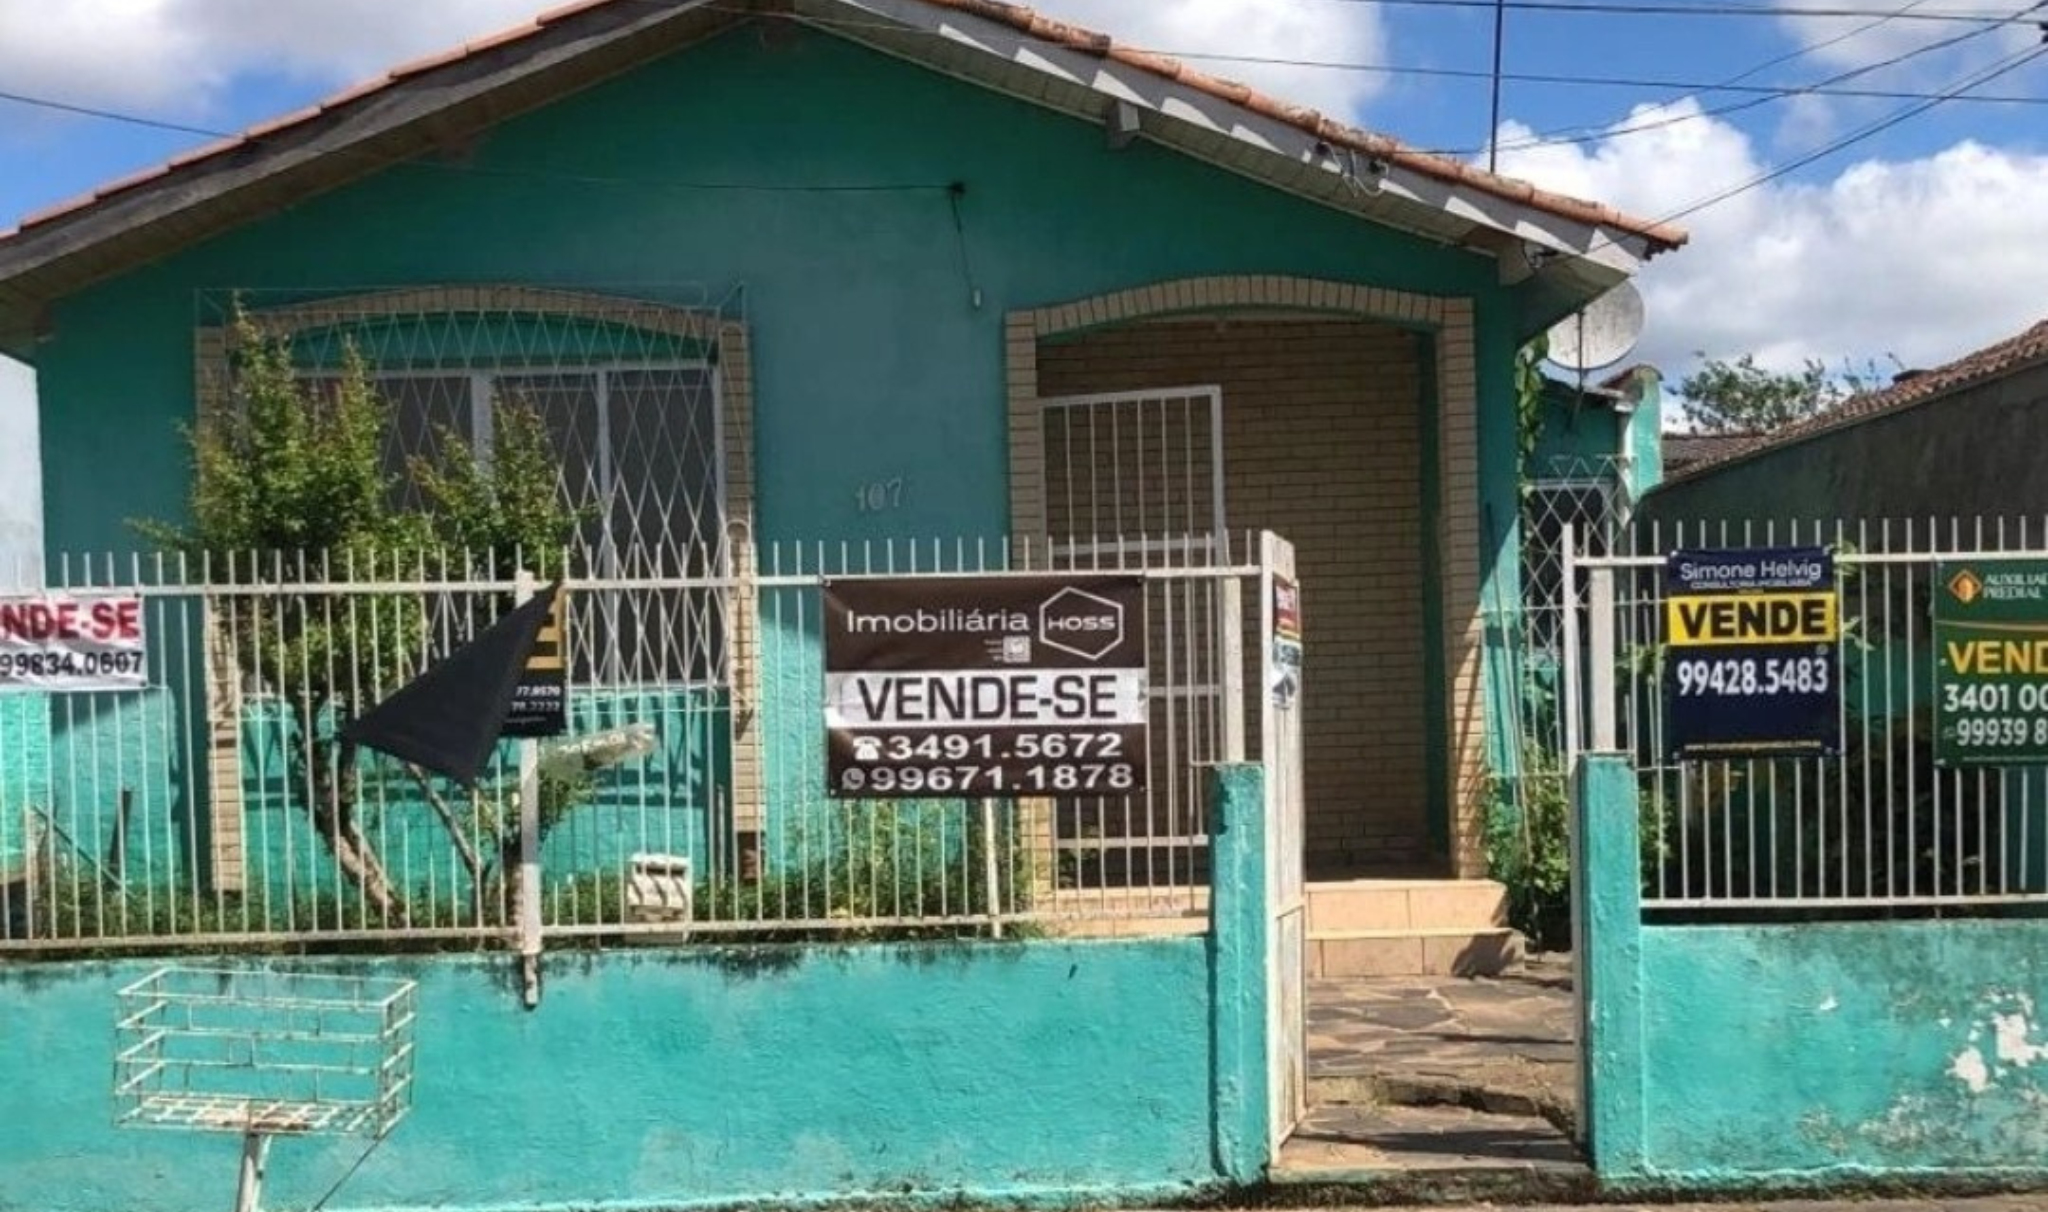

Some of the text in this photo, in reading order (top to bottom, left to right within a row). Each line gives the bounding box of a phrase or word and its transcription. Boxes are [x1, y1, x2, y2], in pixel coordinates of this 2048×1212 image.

[855, 477, 902, 511] 107
[1680, 558, 1822, 581] Simone Helvig
[0, 601, 140, 640] NDE-SE
[847, 607, 1116, 633] Imobiliária HOSS
[1678, 599, 1826, 639] VENDE
[1677, 657, 1829, 697] 99428.5483
[856, 674, 1118, 722] VENDE-SE
[1943, 683, 2010, 712] 3401
[888, 732, 1123, 760] 3491.5672
[1956, 718, 2047, 746] 99939 8
[870, 763, 1133, 791] 99671.1878
